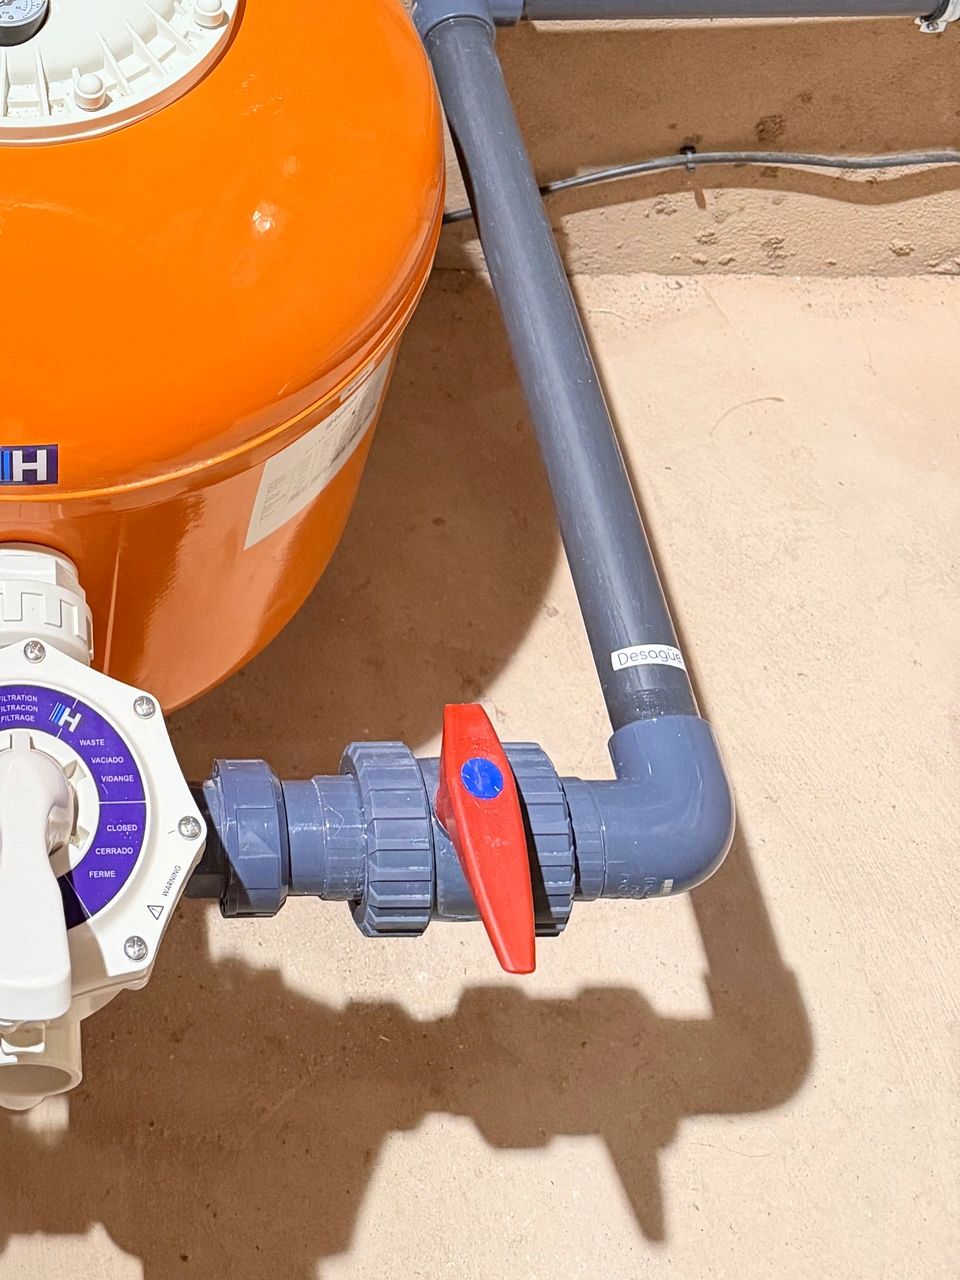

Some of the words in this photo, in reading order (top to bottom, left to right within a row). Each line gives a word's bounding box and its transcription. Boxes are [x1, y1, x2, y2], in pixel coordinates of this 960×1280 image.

[0, 714, 36, 723] FILTRAGE
[79, 738, 105, 746] WASTE
[91, 756, 124, 764] VACIADO
[101, 774, 134, 782] VIDANGE
[106, 824, 138, 832] CLOSED
[95, 846, 134, 855] CERRADO
[88, 870, 116, 879] FERME
[161, 864, 182, 897] WARNING
